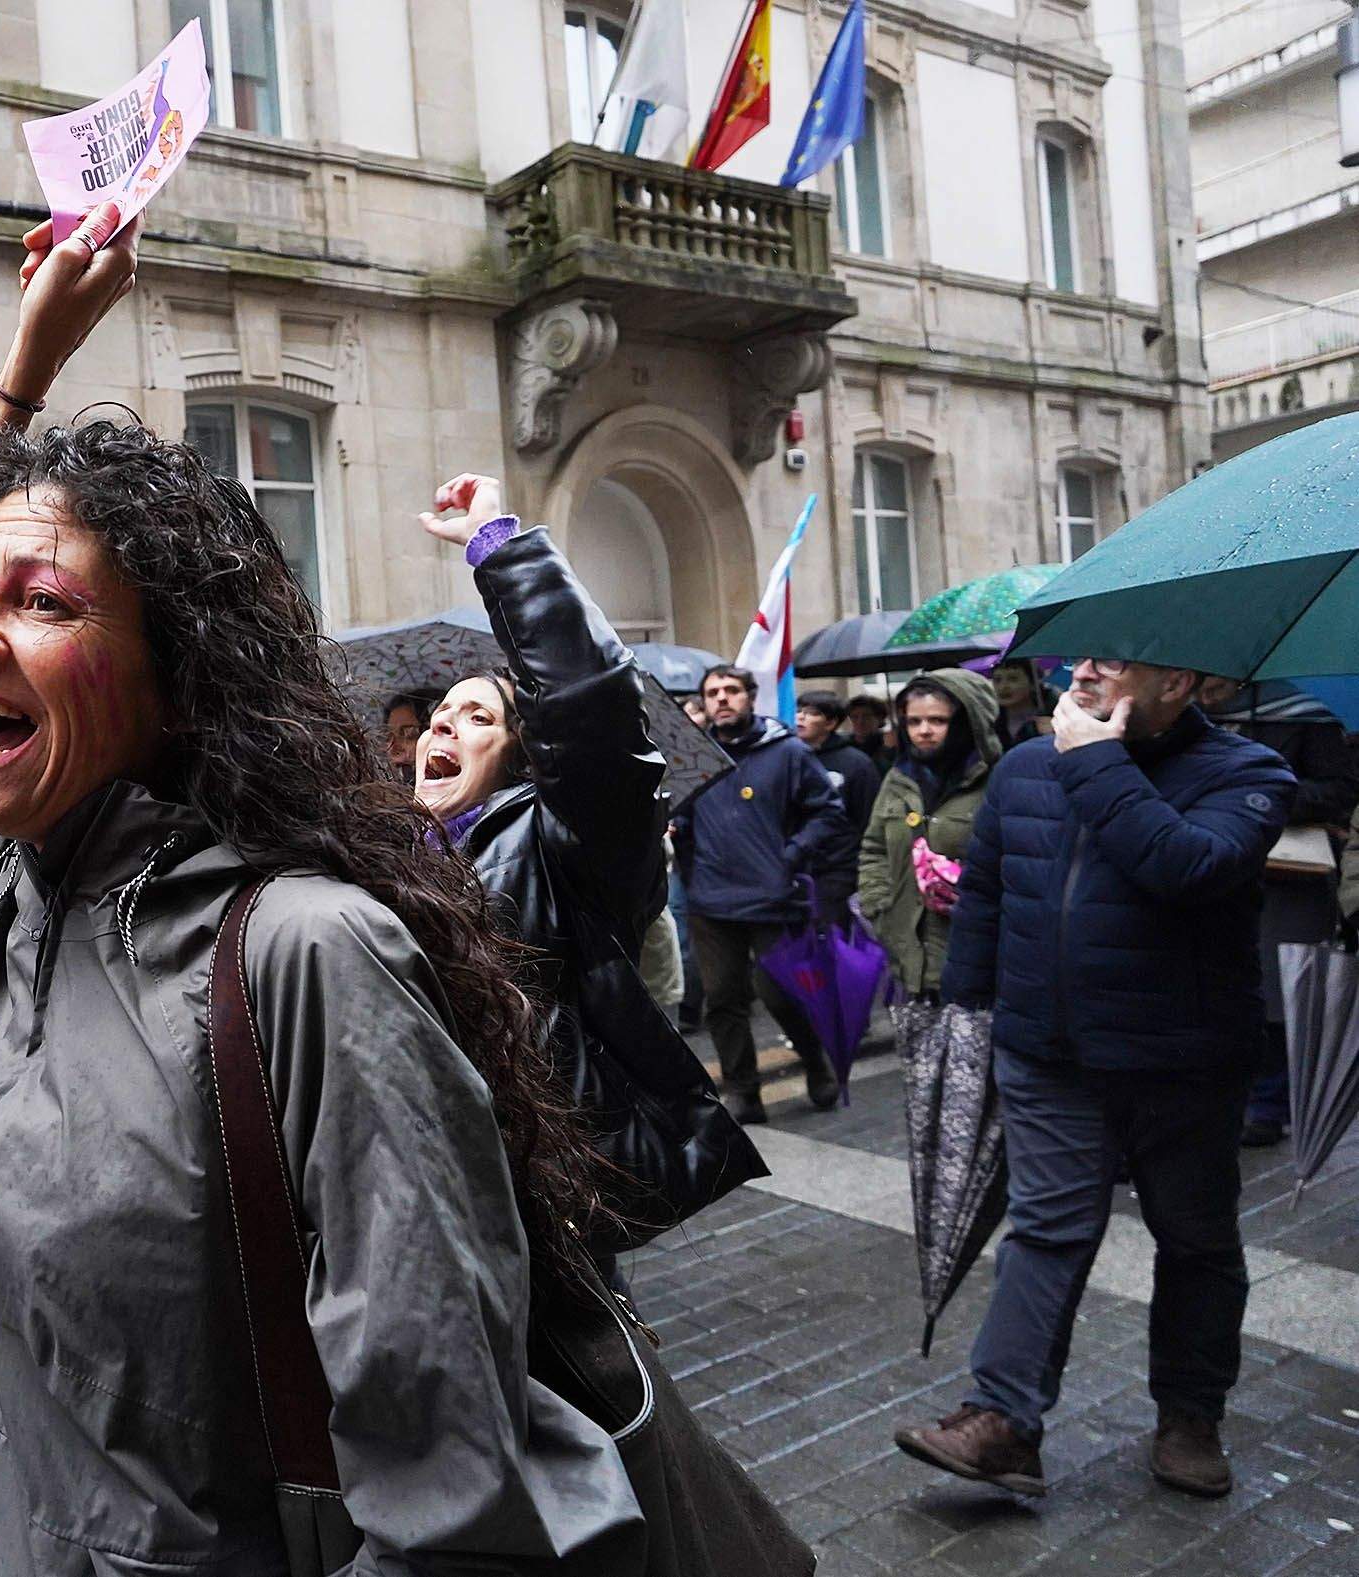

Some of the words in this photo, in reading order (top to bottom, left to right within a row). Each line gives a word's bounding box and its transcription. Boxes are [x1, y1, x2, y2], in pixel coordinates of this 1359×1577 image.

[69, 122, 93, 135] bng
[120, 111, 146, 147] NIN
[80, 133, 121, 165] VER-
[126, 131, 149, 168] NIN
[81, 153, 127, 192] MEDO
